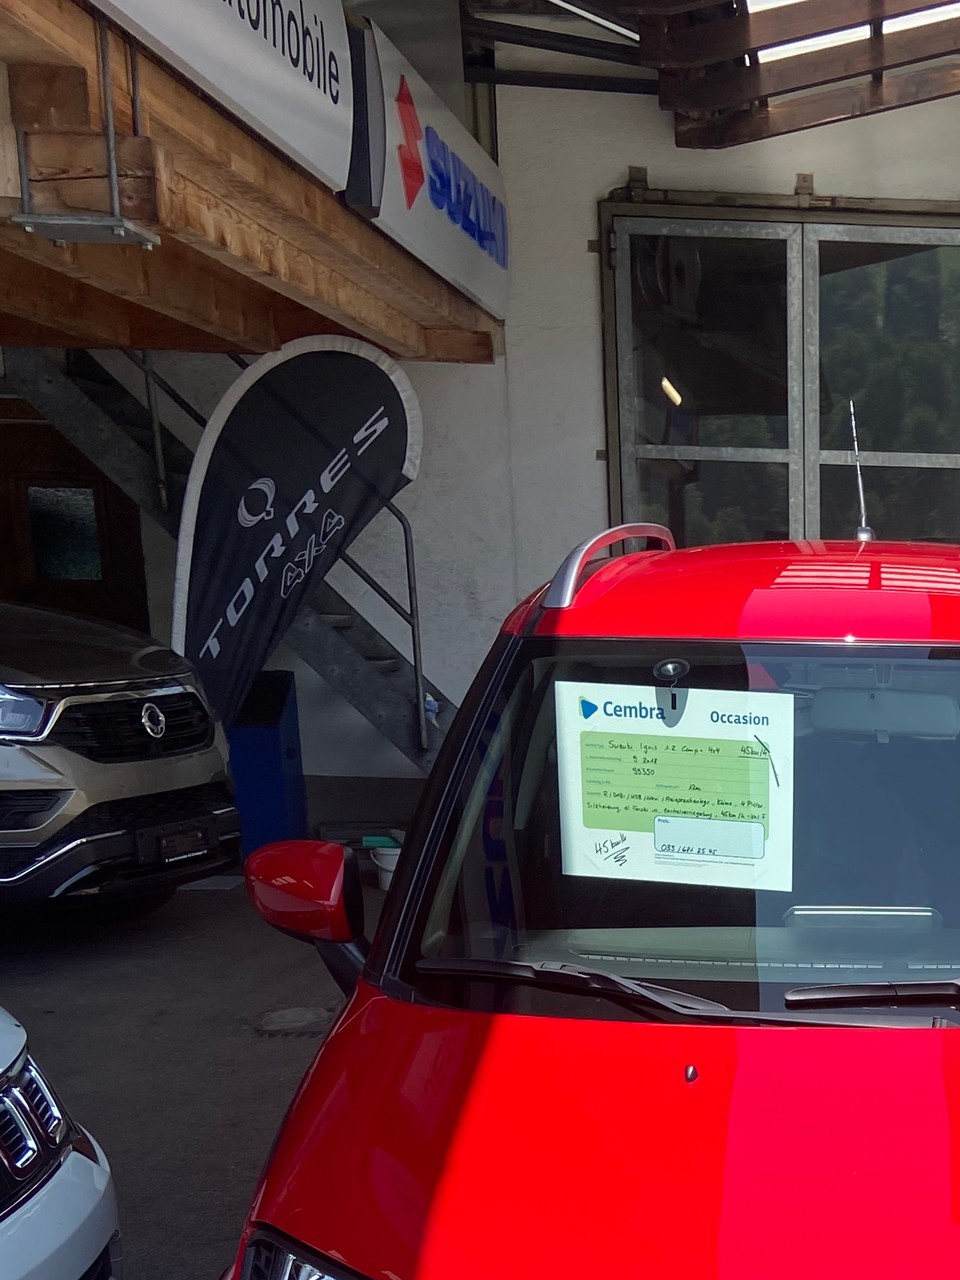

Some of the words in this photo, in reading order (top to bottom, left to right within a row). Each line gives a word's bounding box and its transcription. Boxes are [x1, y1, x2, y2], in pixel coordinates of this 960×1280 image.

[199, 405, 390, 660] TORRES
[602, 701, 666, 720] Cembra
[710, 711, 770, 726] Occasion
